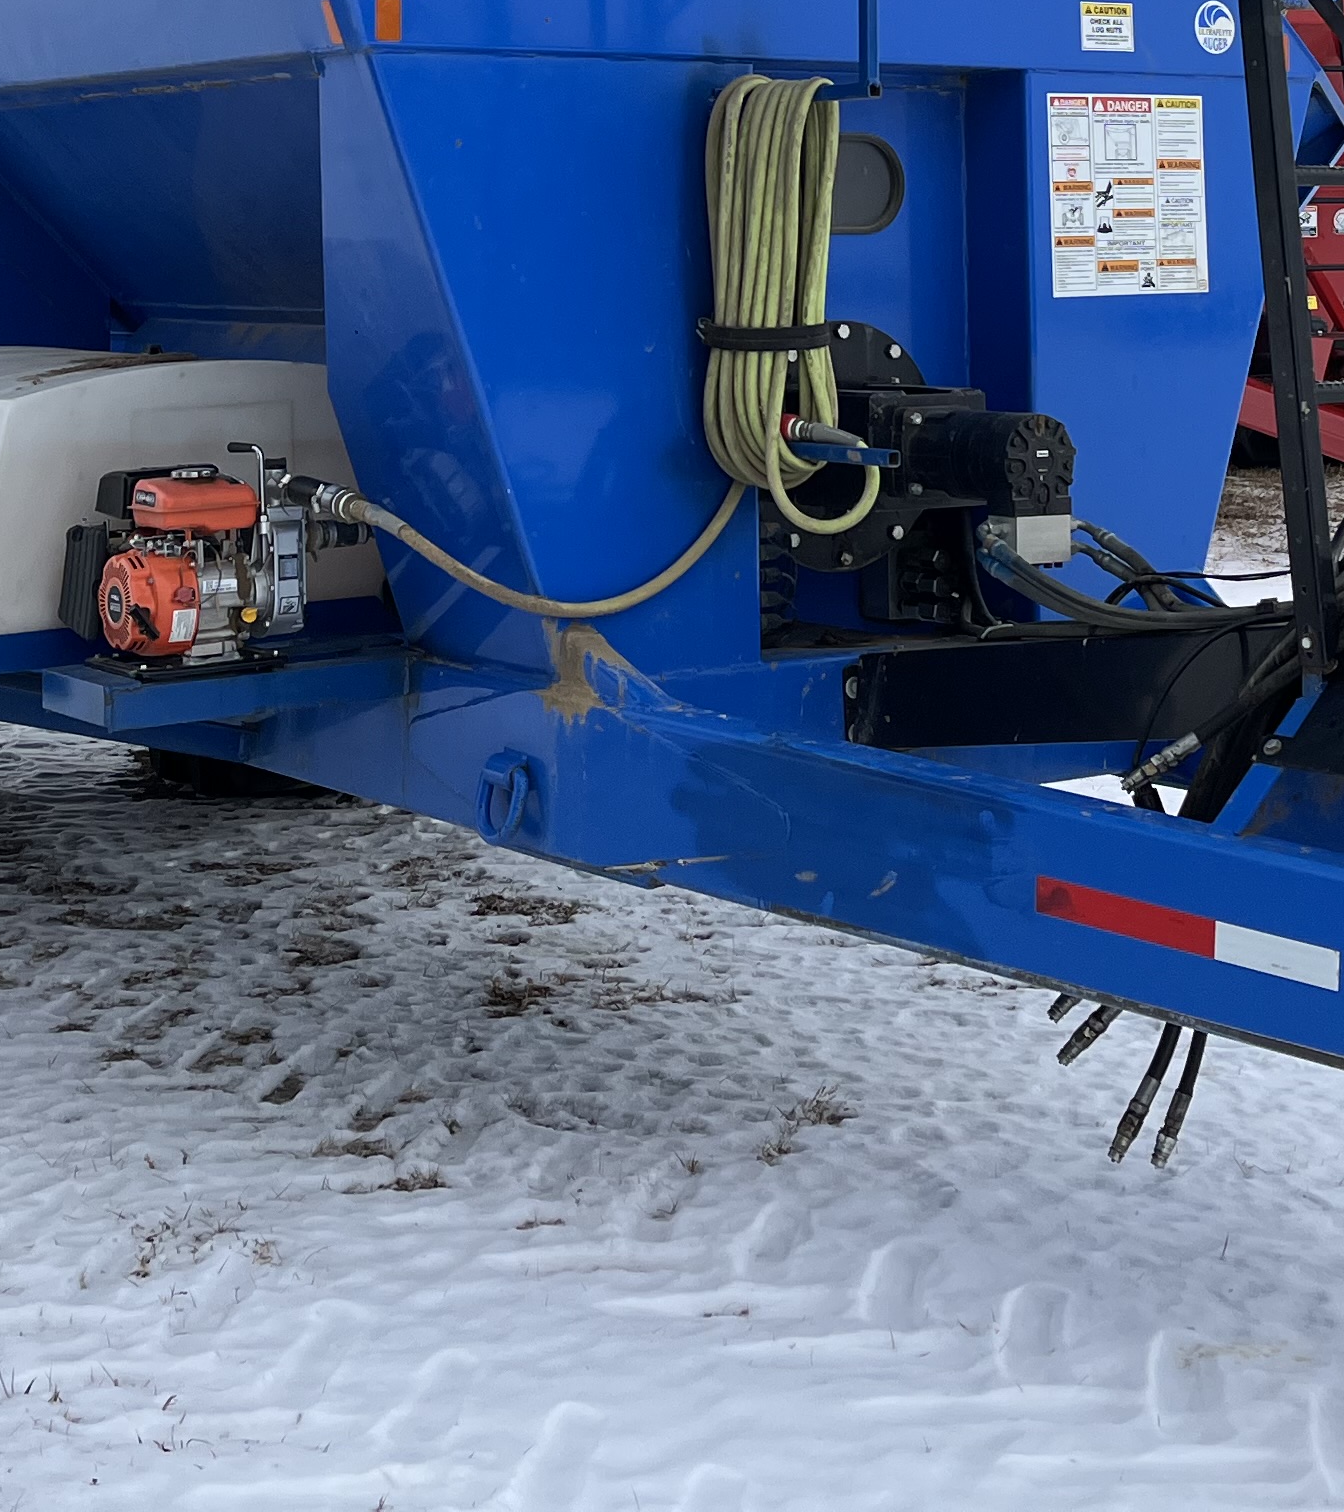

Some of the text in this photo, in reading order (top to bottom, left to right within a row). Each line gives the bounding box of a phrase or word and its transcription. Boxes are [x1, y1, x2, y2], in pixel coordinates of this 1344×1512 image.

[1093, 6, 1128, 15] CAUTION
[1203, 37, 1228, 52] AUGER
[1106, 100, 1149, 112] DANGER
[1165, 100, 1197, 109] CAUTION
[1166, 161, 1200, 169] WARNING
[1063, 238, 1094, 246] WARNING
